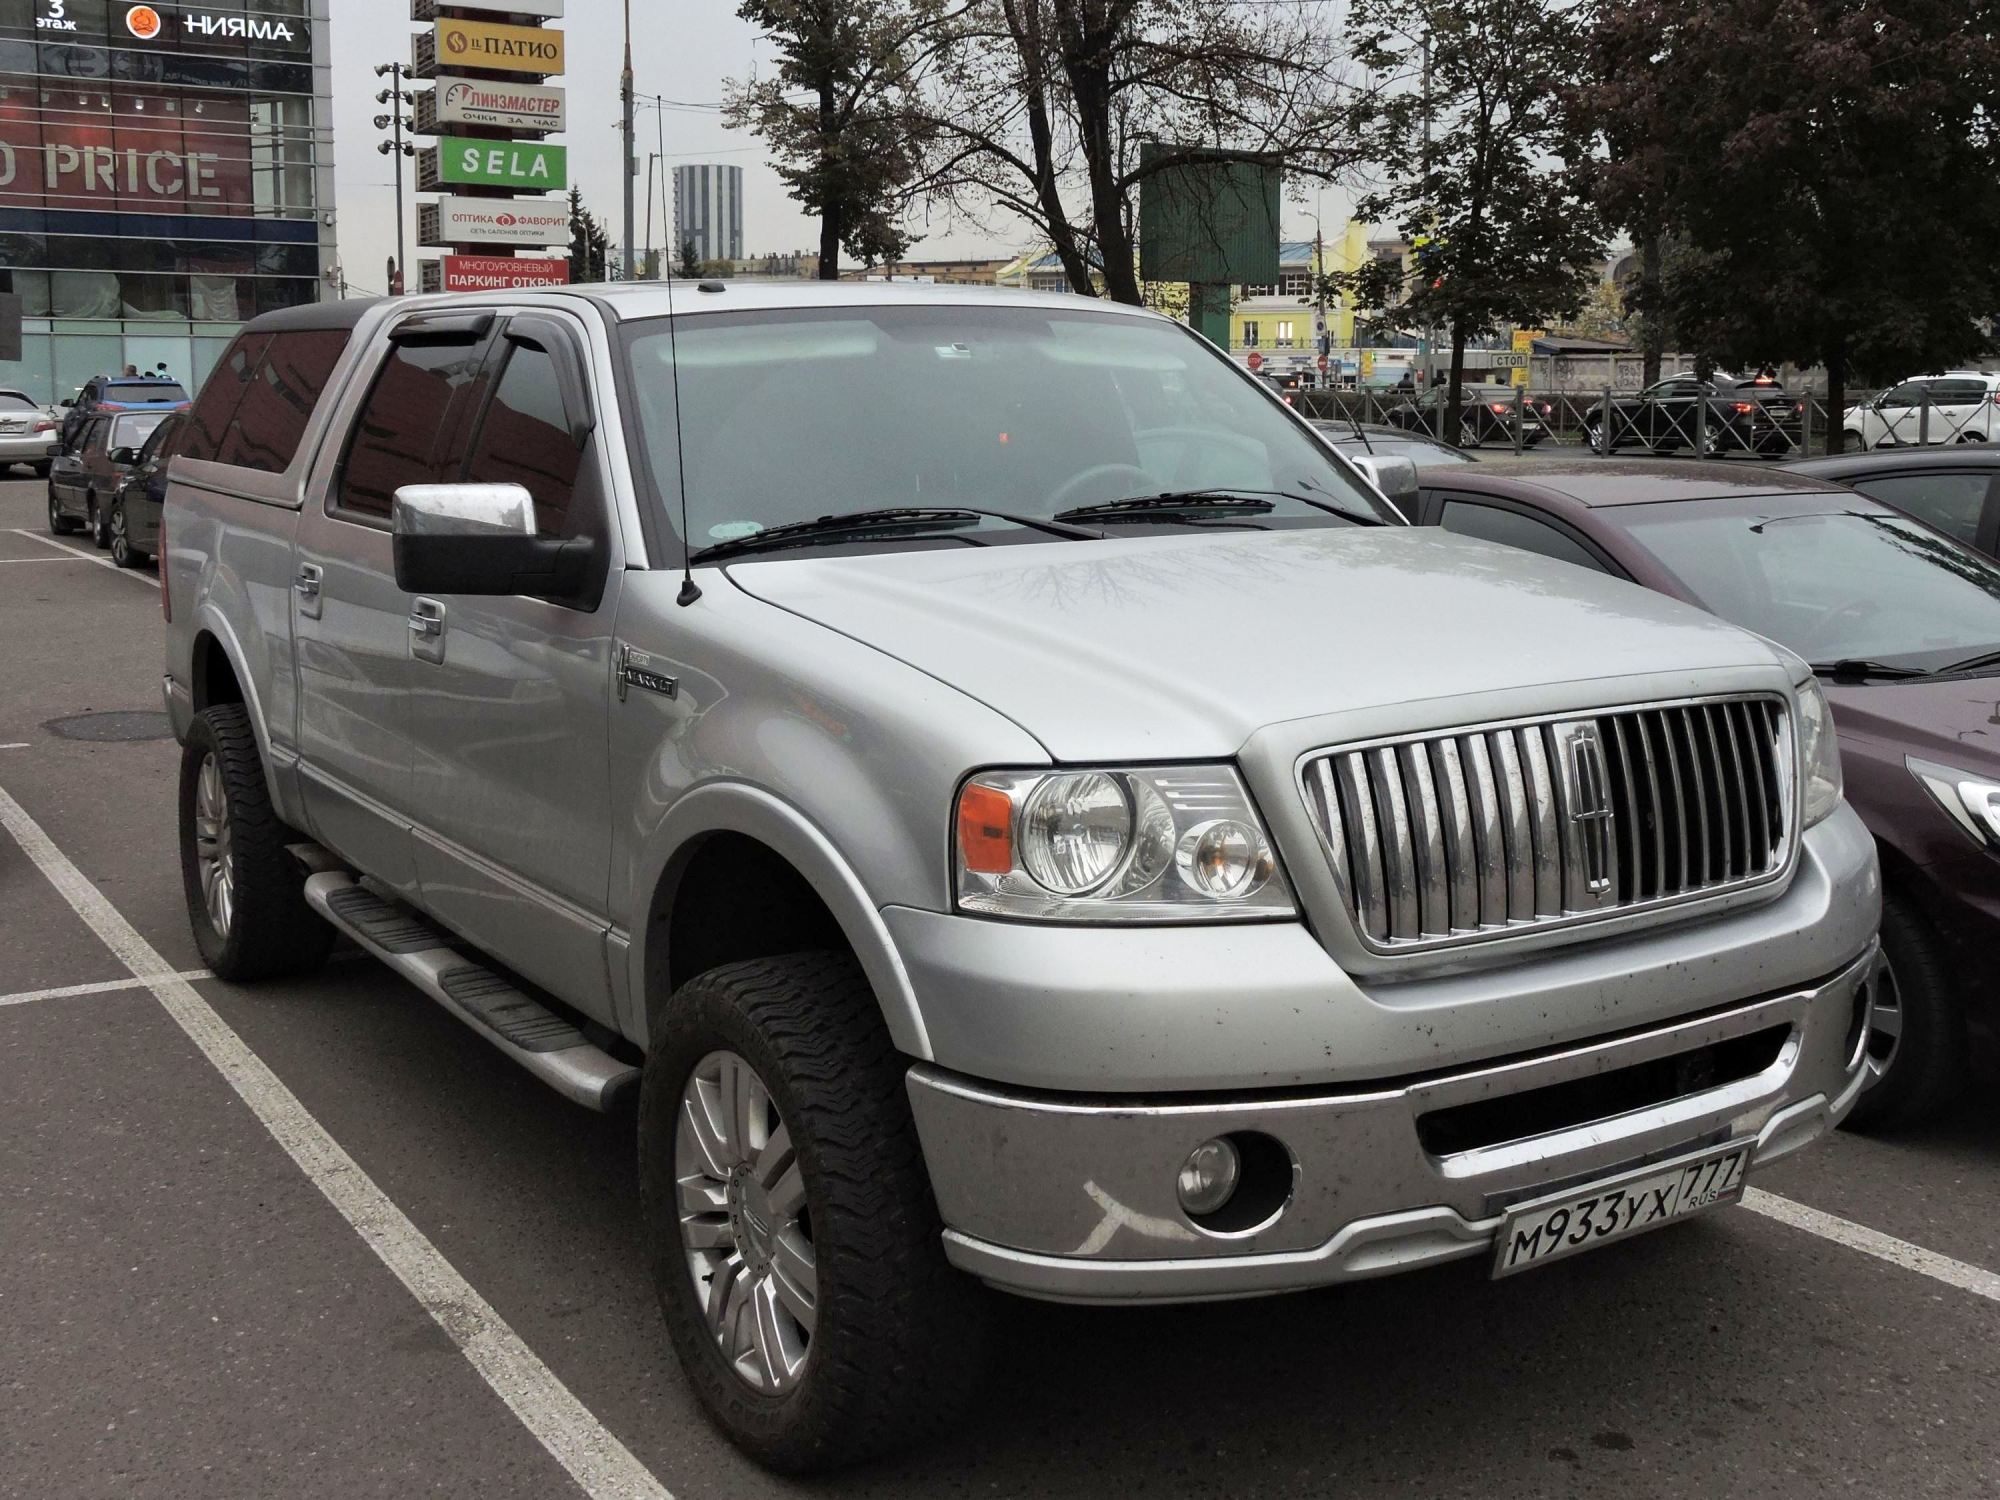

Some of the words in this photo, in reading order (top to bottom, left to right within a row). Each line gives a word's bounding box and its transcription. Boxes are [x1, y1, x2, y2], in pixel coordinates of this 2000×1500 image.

[48, 0, 65, 18] 3
[35, 17, 77, 31] этаж
[183, 14, 294, 42] НИЯМА
[484, 37, 558, 60] ПАТИО
[470, 91, 560, 113] ЛИНЗМАСТЕР
[462, 113, 497, 122] ОЧКИ
[507, 117, 524, 125] ЗА
[533, 119, 558, 127] ЧАС
[45, 143, 221, 197] PRICE
[462, 148, 549, 178] SELA
[452, 213, 494, 224] ОПТИКА
[518, 216, 566, 226] ФАВОРИТ
[459, 260, 554, 273] МНОГОУРОВНЕВЫЙ
[449, 274, 510, 288] ПАРКИНГ
[512, 276, 564, 288] ОТКРЫТ
[1496, 355, 1523, 367] СТОП
[1688, 1190, 1718, 1209] RUS
[1510, 1183, 1675, 1266] М933УХ
[1684, 1155, 1740, 1198] 777
